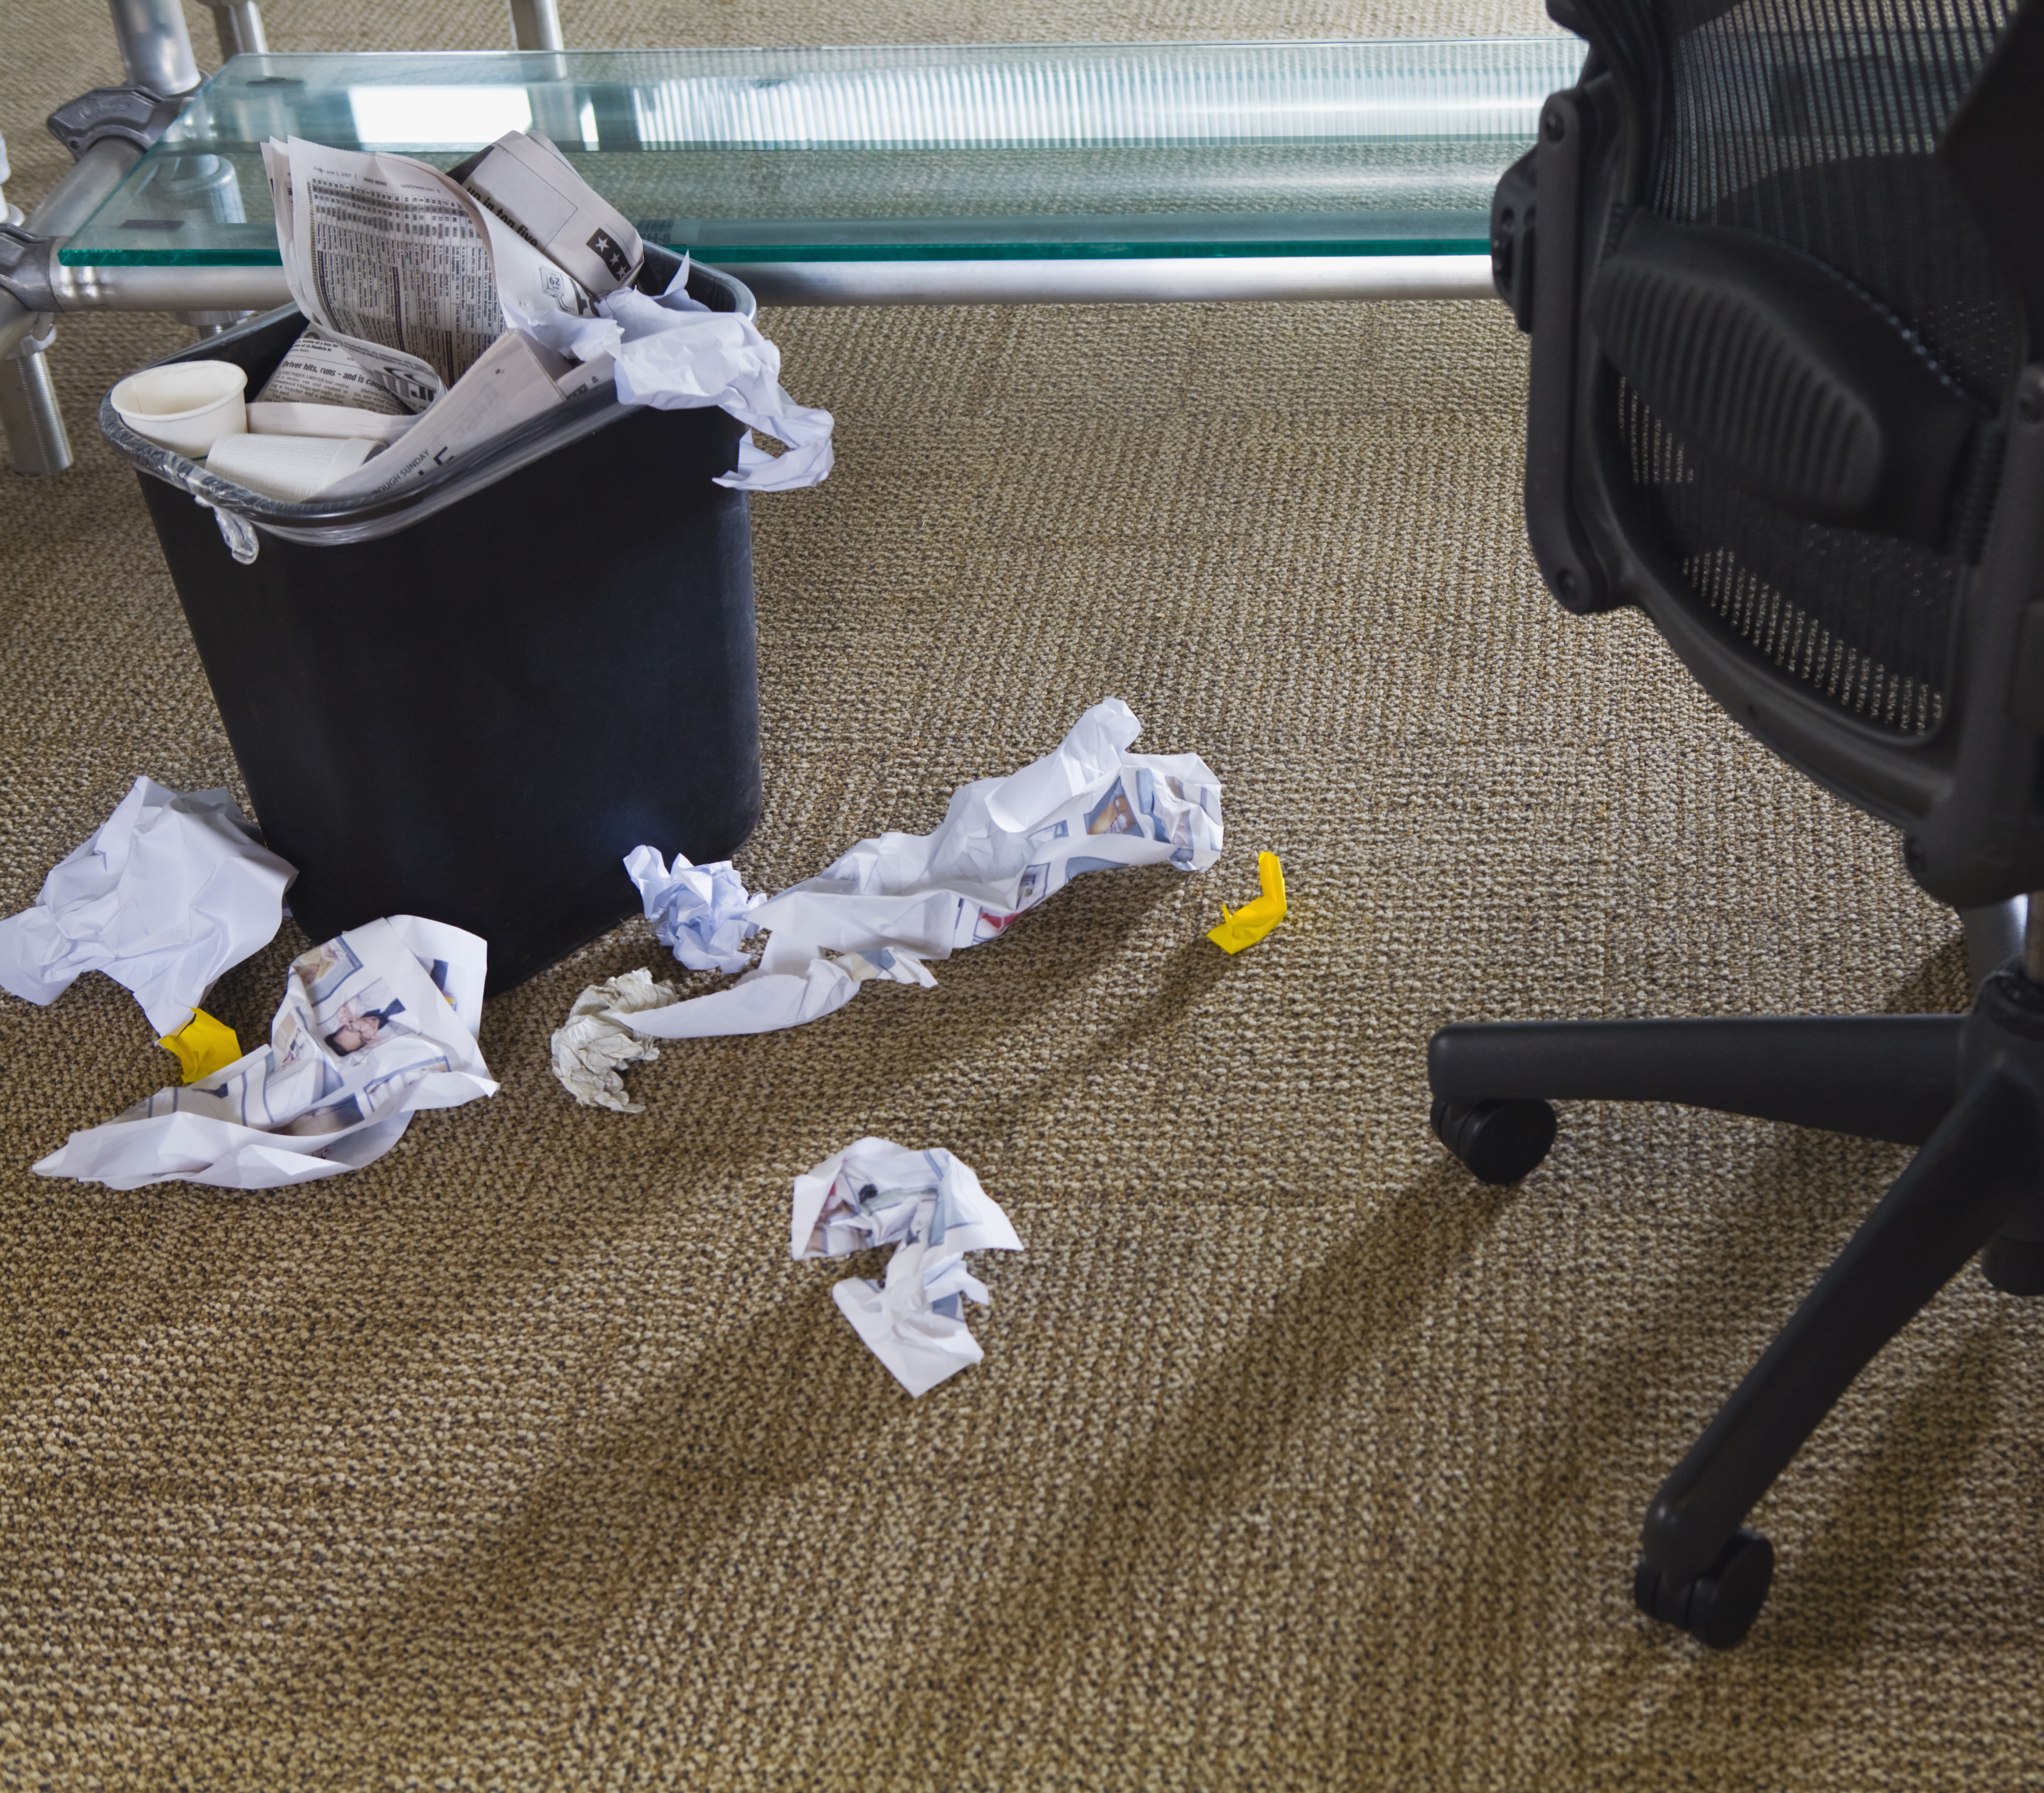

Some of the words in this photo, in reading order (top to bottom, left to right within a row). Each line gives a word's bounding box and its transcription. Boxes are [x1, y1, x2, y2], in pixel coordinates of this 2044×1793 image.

[516, 224, 538, 247] five
[283, 360, 303, 369] Driver
[303, 363, 318, 374] hits,
[320, 367, 336, 376] runs
[343, 372, 358, 381] and
[358, 374, 365, 383] is
[366, 378, 391, 394] caught
[306, 374, 325, 383] DRIVER
[333, 381, 350, 389] control
[273, 379, 297, 387] Greenwich
[296, 383, 312, 391] Village
[321, 388, 333, 397] night,
[284, 385, 303, 394] bicyclist
[319, 395, 344, 404] pedestrian.
[323, 384, 341, 392] crashed
[360, 387, 380, 398] Sherwin
[352, 397, 375, 407] restaurant
[400, 448, 430, 478] SUNDAY
